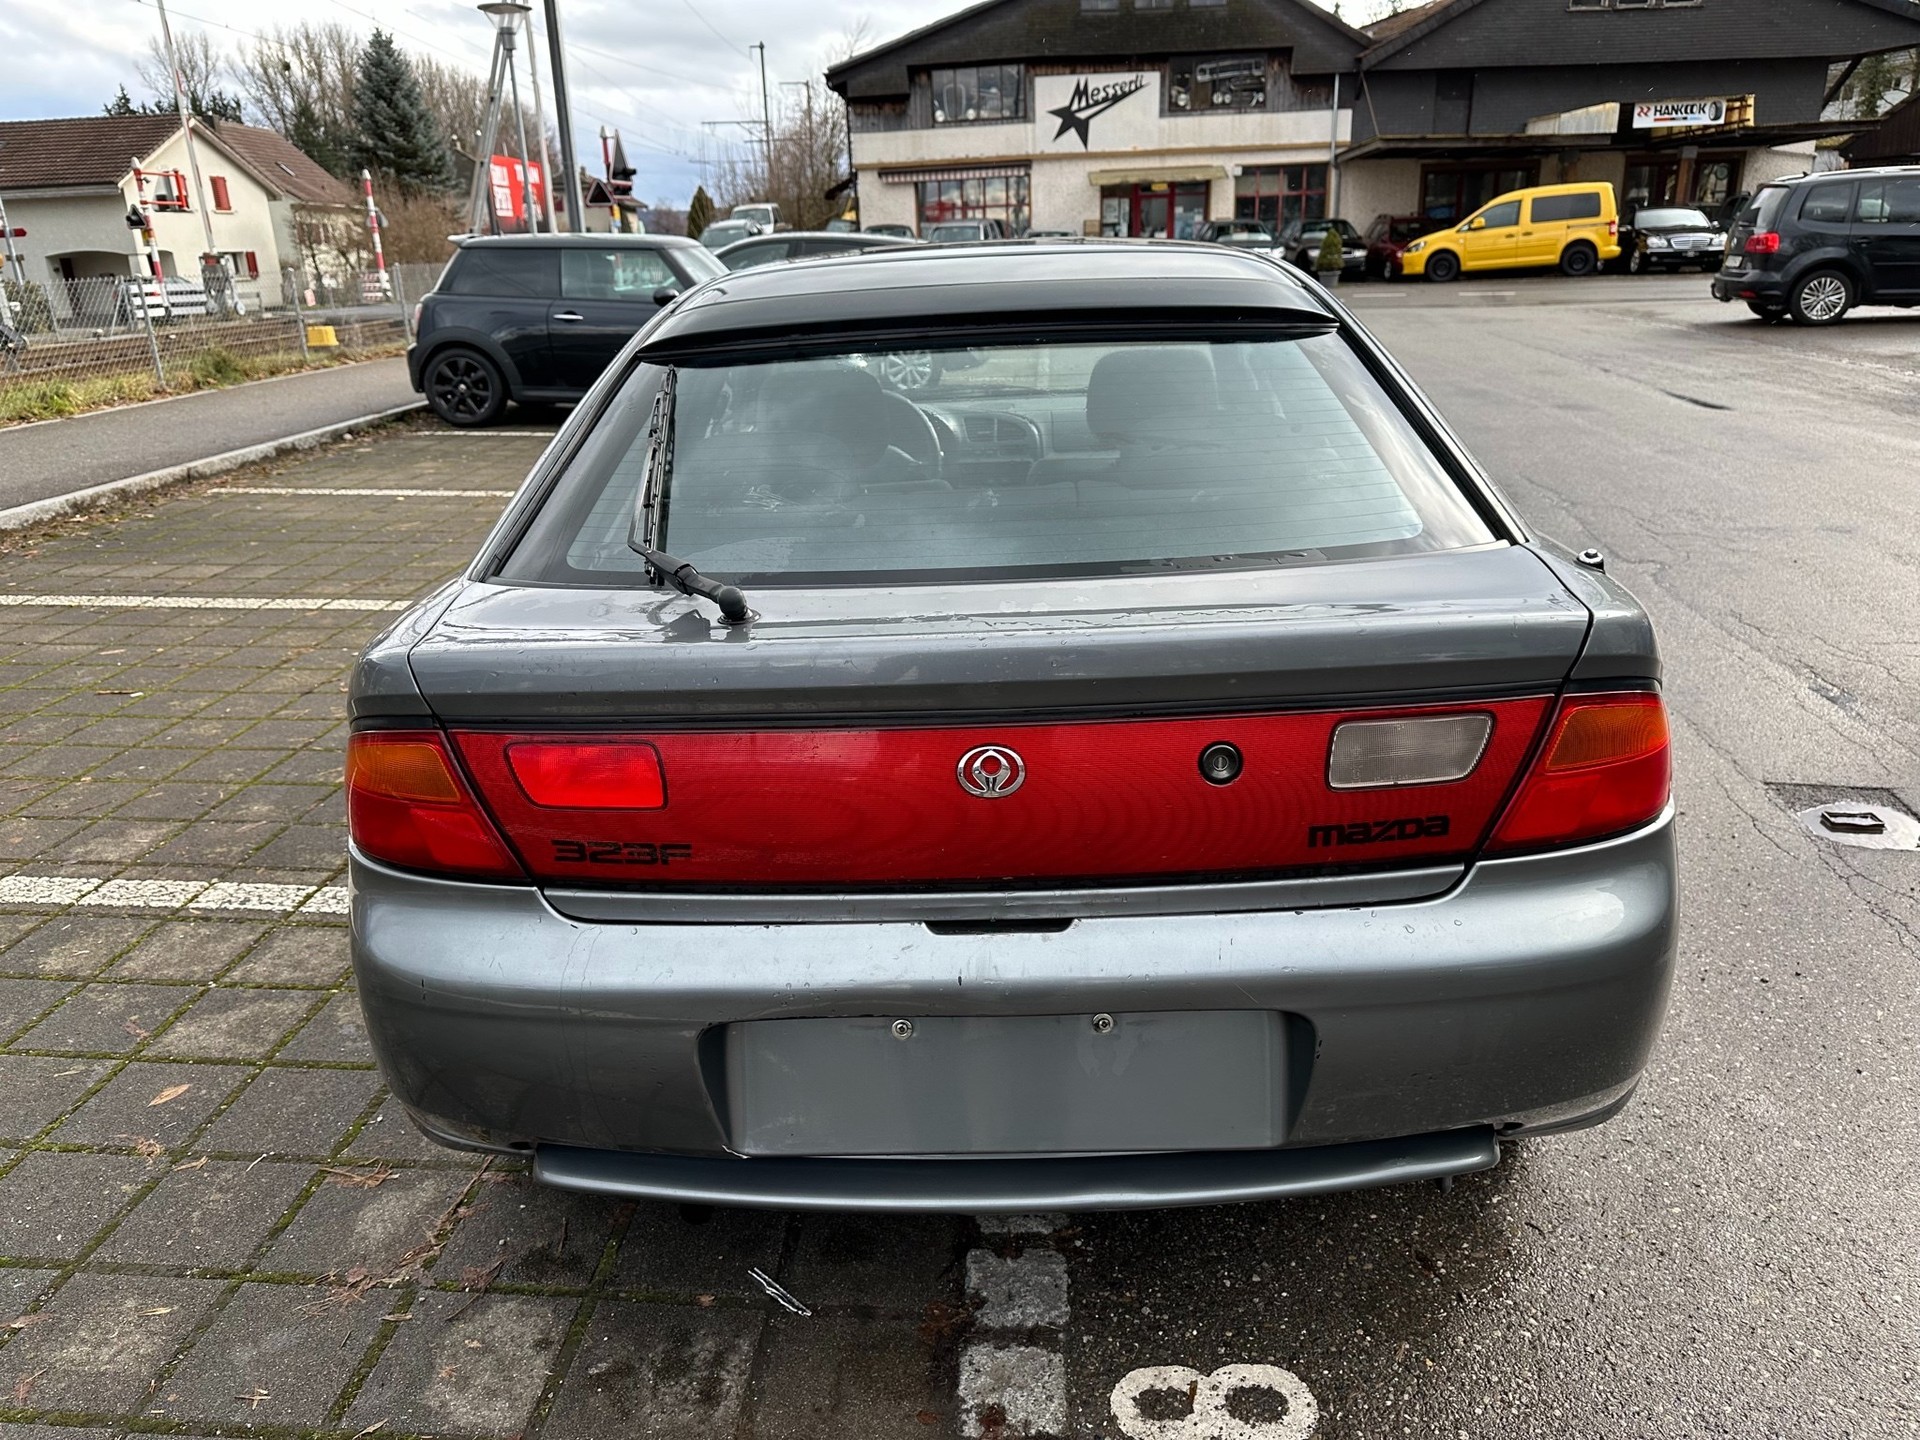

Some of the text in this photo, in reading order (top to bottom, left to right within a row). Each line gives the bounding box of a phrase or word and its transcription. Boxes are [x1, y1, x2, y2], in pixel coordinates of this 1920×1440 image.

[1069, 74, 1144, 110] Messerli
[1653, 102, 1707, 117] HANKOOK
[551, 839, 692, 866] 323F
